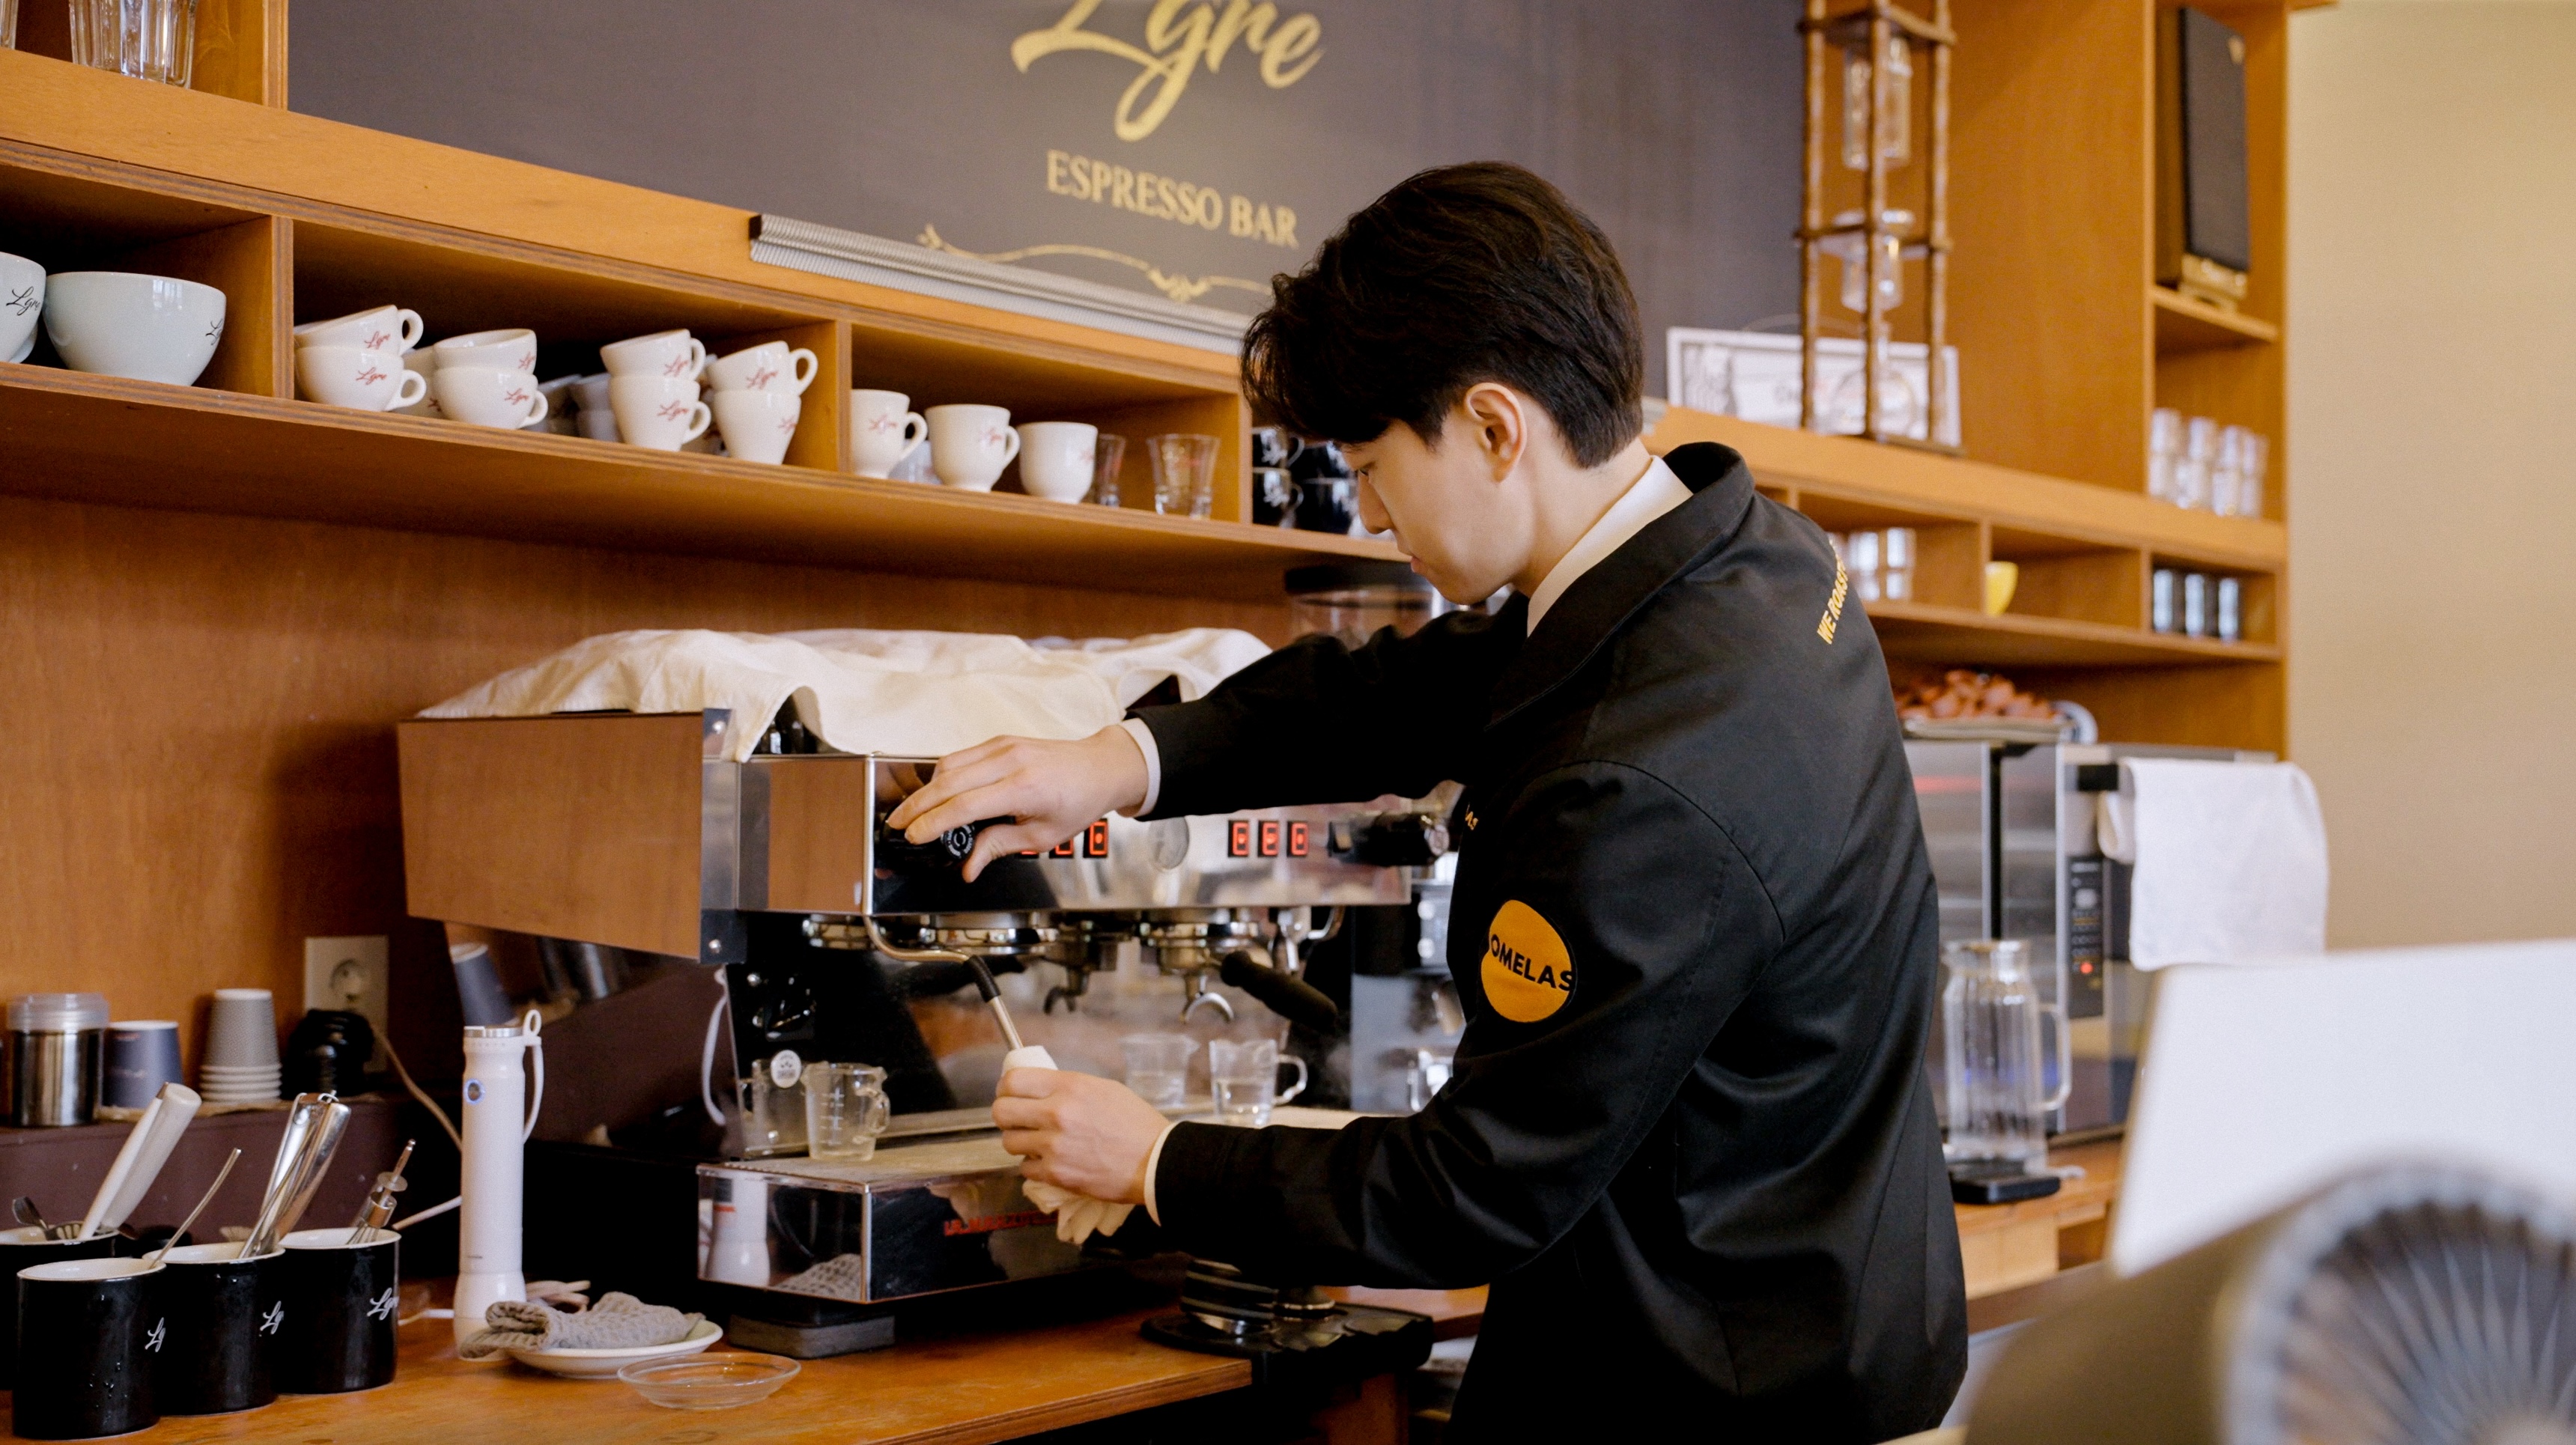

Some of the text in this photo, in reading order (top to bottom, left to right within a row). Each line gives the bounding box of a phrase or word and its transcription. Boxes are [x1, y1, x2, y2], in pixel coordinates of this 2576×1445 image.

[1047, 149, 1299, 249] ESPRESSO BAR
[1817, 609, 1837, 645] WE
[1490, 934, 1573, 992] OMELAS
